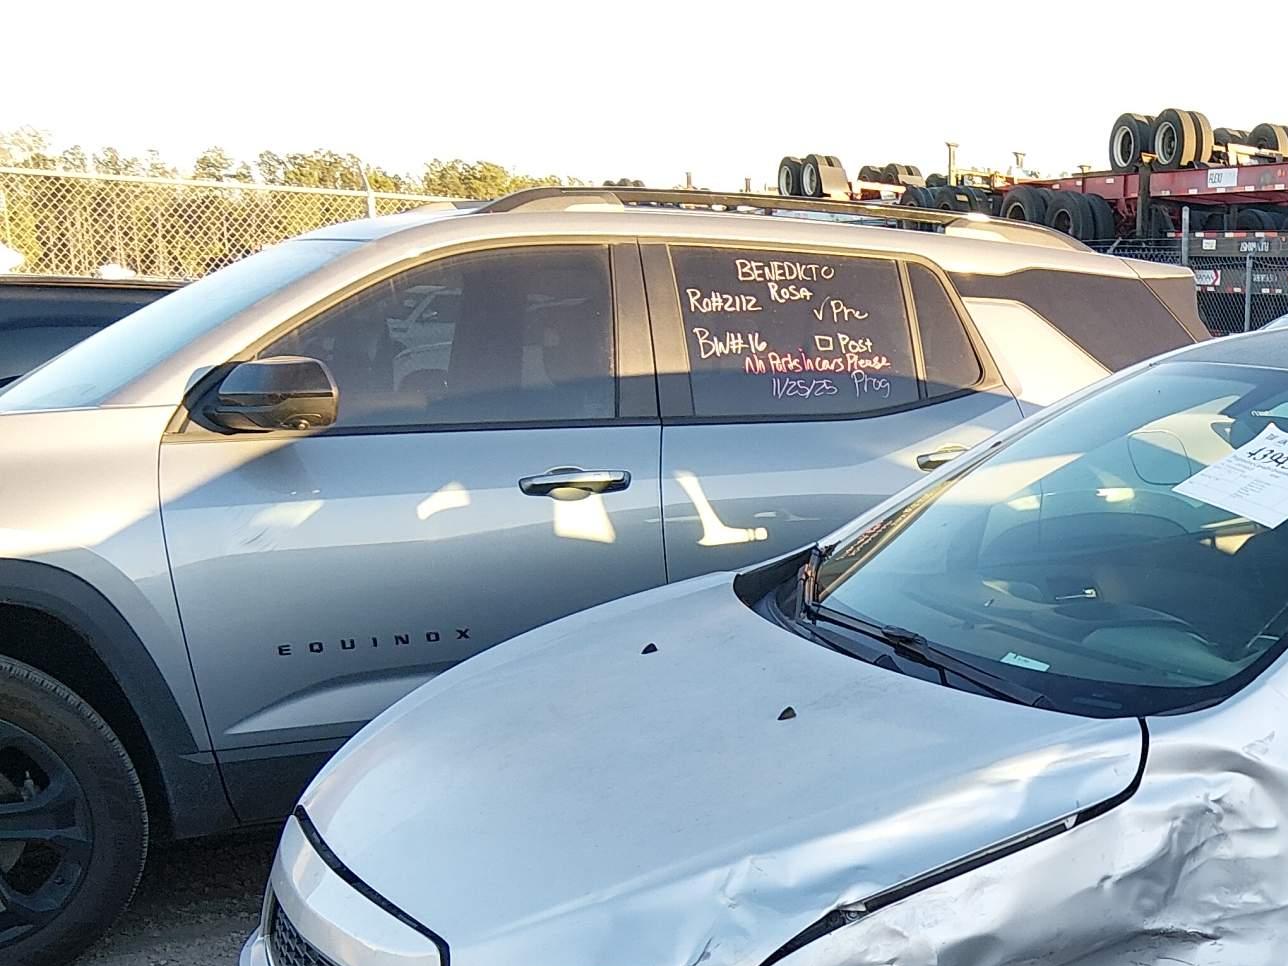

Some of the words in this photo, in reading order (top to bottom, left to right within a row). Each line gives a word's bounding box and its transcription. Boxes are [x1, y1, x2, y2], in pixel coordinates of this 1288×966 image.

[830, 299, 868, 322] Pre
[837, 332, 873, 354] Post
[845, 353, 891, 372] Please
[772, 376, 839, 399] 11/25/25
[850, 369, 890, 398] Prog
[278, 627, 470, 656] EQUINOX
